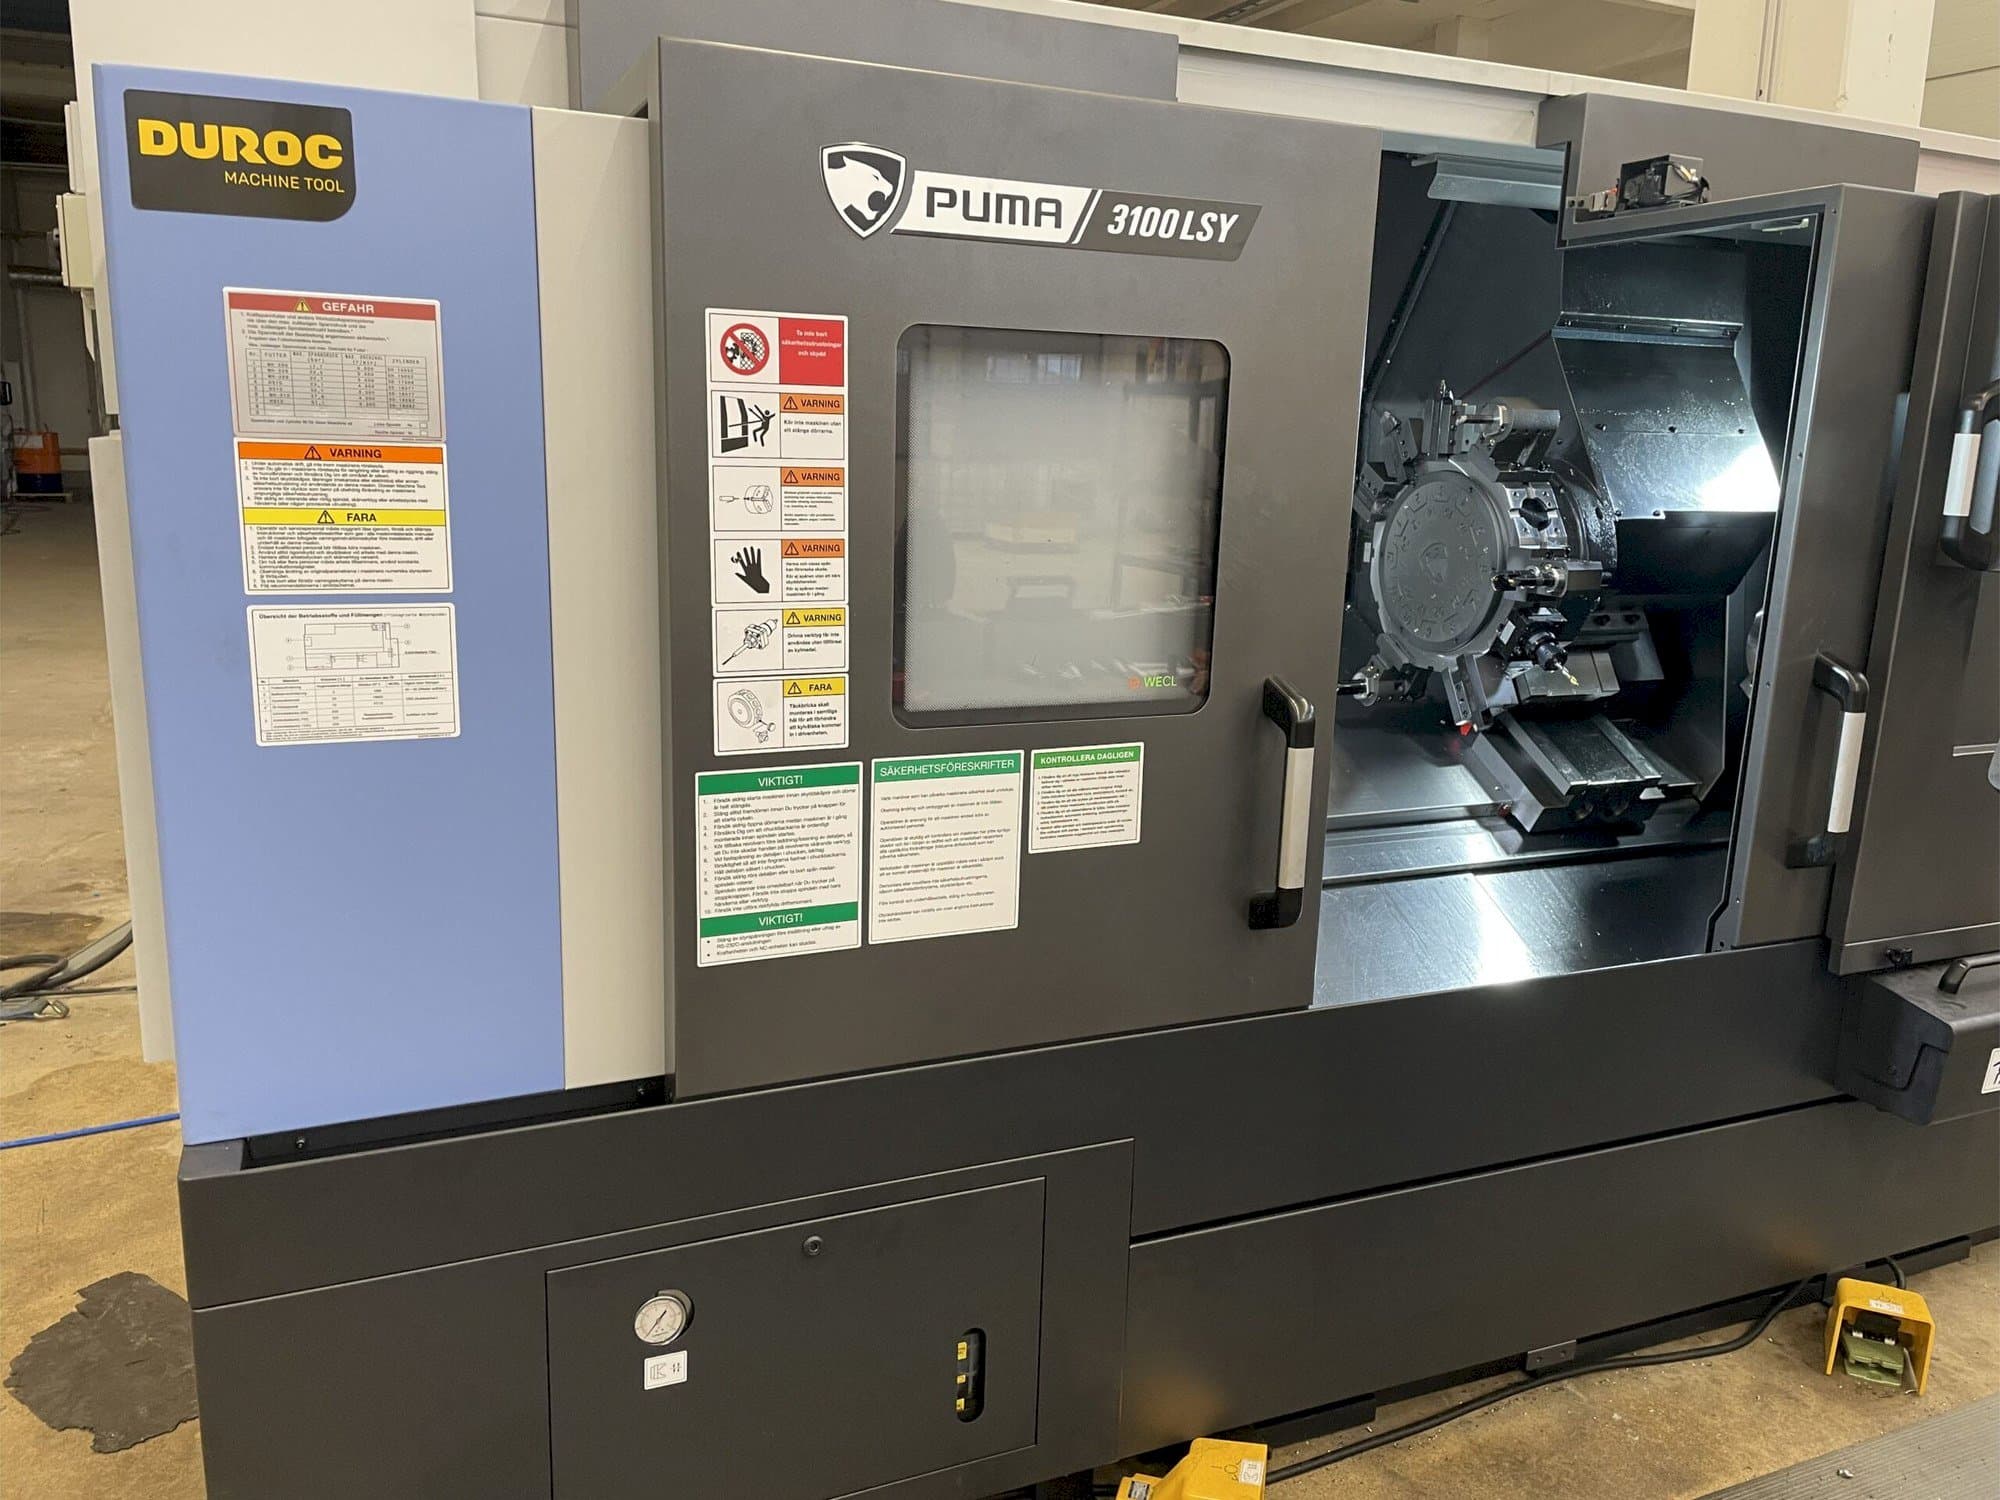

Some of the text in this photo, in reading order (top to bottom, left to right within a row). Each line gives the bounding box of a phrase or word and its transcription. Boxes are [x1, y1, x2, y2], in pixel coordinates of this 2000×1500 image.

[137, 118, 343, 170] DUROC
[224, 170, 345, 193] MACHINE TOOL
[925, 186, 1062, 229] PUMA
[322, 302, 375, 314] GEFAHR
[801, 399, 840, 409] VARNING
[330, 448, 382, 459] VARNING
[801, 473, 840, 481] VARNING
[347, 513, 377, 523] FARA
[802, 544, 840, 553] VARNING
[804, 613, 841, 622] VARNING
[809, 683, 833, 691] FARA
[1040, 750, 1135, 765] KONTROLLERA DAGLIGEN
[880, 759, 1015, 777] SÄKERHETSFÖRESKRIFTER
[757, 775, 803, 787] VIKTIGT!
[758, 913, 803, 927] VIKTIGT!
